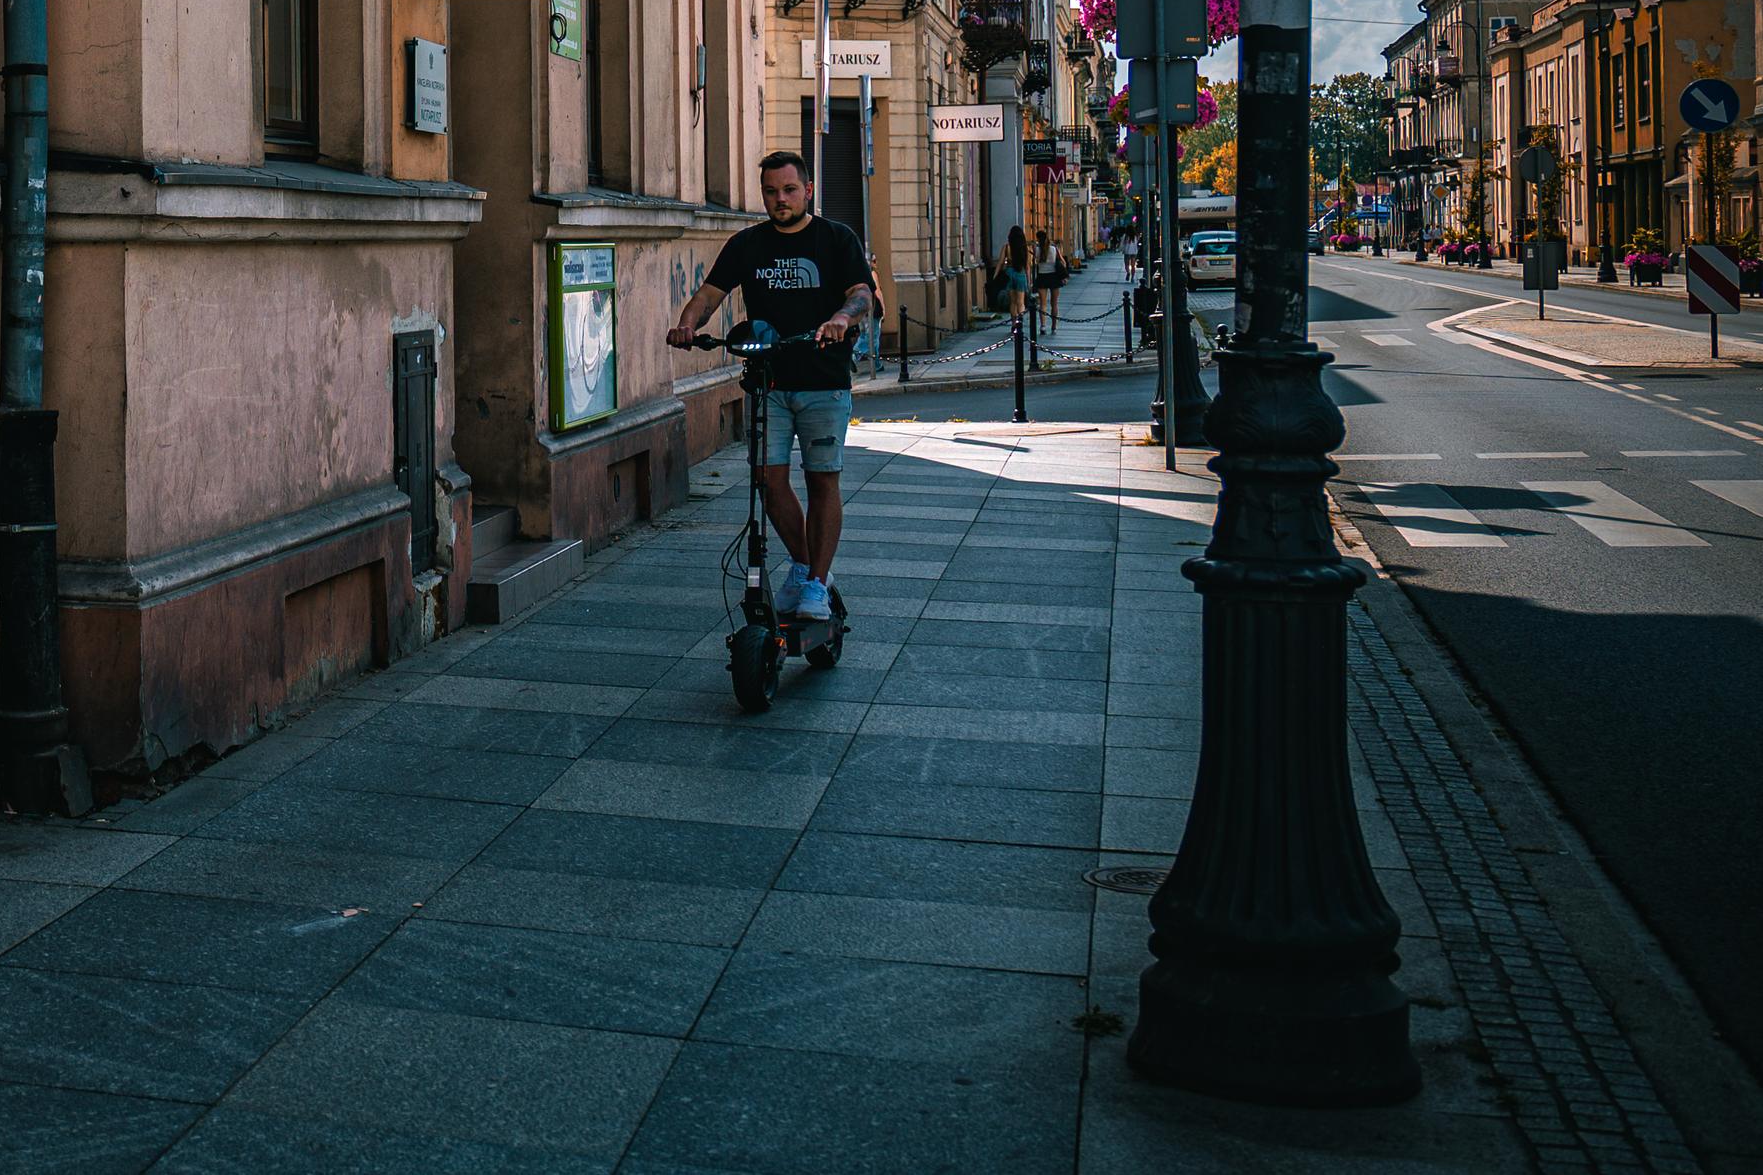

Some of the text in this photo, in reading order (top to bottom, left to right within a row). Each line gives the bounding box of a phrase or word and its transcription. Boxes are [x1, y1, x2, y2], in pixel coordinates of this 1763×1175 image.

[814, 53, 881, 66] TARIUSZ
[932, 116, 1001, 130] NOTARIUSZ
[774, 258, 797, 268] THE
[756, 268, 797, 279] NORTH
[768, 279, 797, 289] FACE
